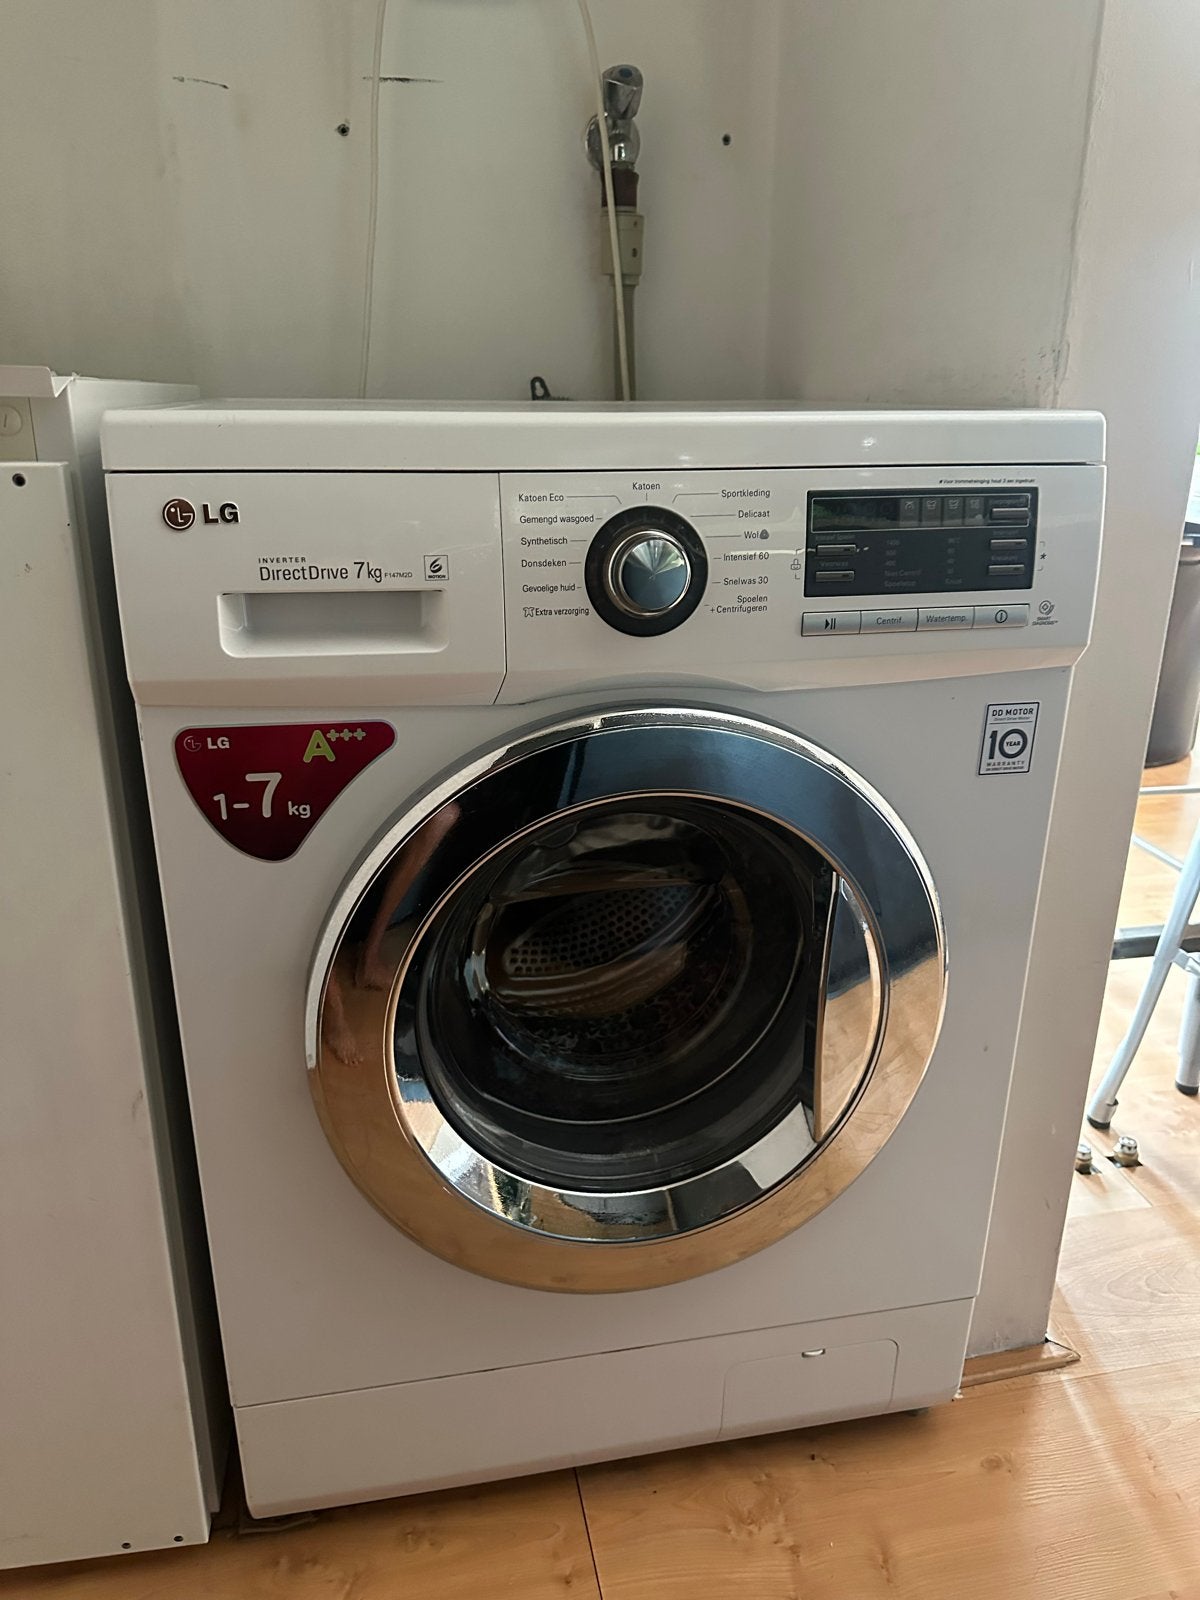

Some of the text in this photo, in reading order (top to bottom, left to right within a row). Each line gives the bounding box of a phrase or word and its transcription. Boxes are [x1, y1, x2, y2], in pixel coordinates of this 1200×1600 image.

[632, 482, 661, 491] Katoen
[518, 493, 564, 502] Katoen Eco
[721, 489, 771, 499] Sportkleding
[202, 502, 240, 525] LG
[738, 509, 770, 518] Delicaat
[519, 514, 594, 525] Gemengd wasgoed
[744, 530, 760, 539] Wol
[520, 536, 568, 547] Synthetisch
[258, 556, 307, 564] INVERTER
[723, 551, 770, 561] Intensief 60
[521, 559, 567, 568] Donsdeken
[723, 575, 769, 586] Snelwas 30
[522, 583, 576, 594] Gevoelige huid
[737, 594, 768, 604] Spoelen
[535, 606, 590, 616] Extra verzorging
[716, 604, 768, 614] Centrifugeren
[992, 707, 1034, 717] DD MOTOR
[206, 736, 231, 750] LG
[988, 728, 1028, 760] 10
[287, 800, 312, 819] kg
